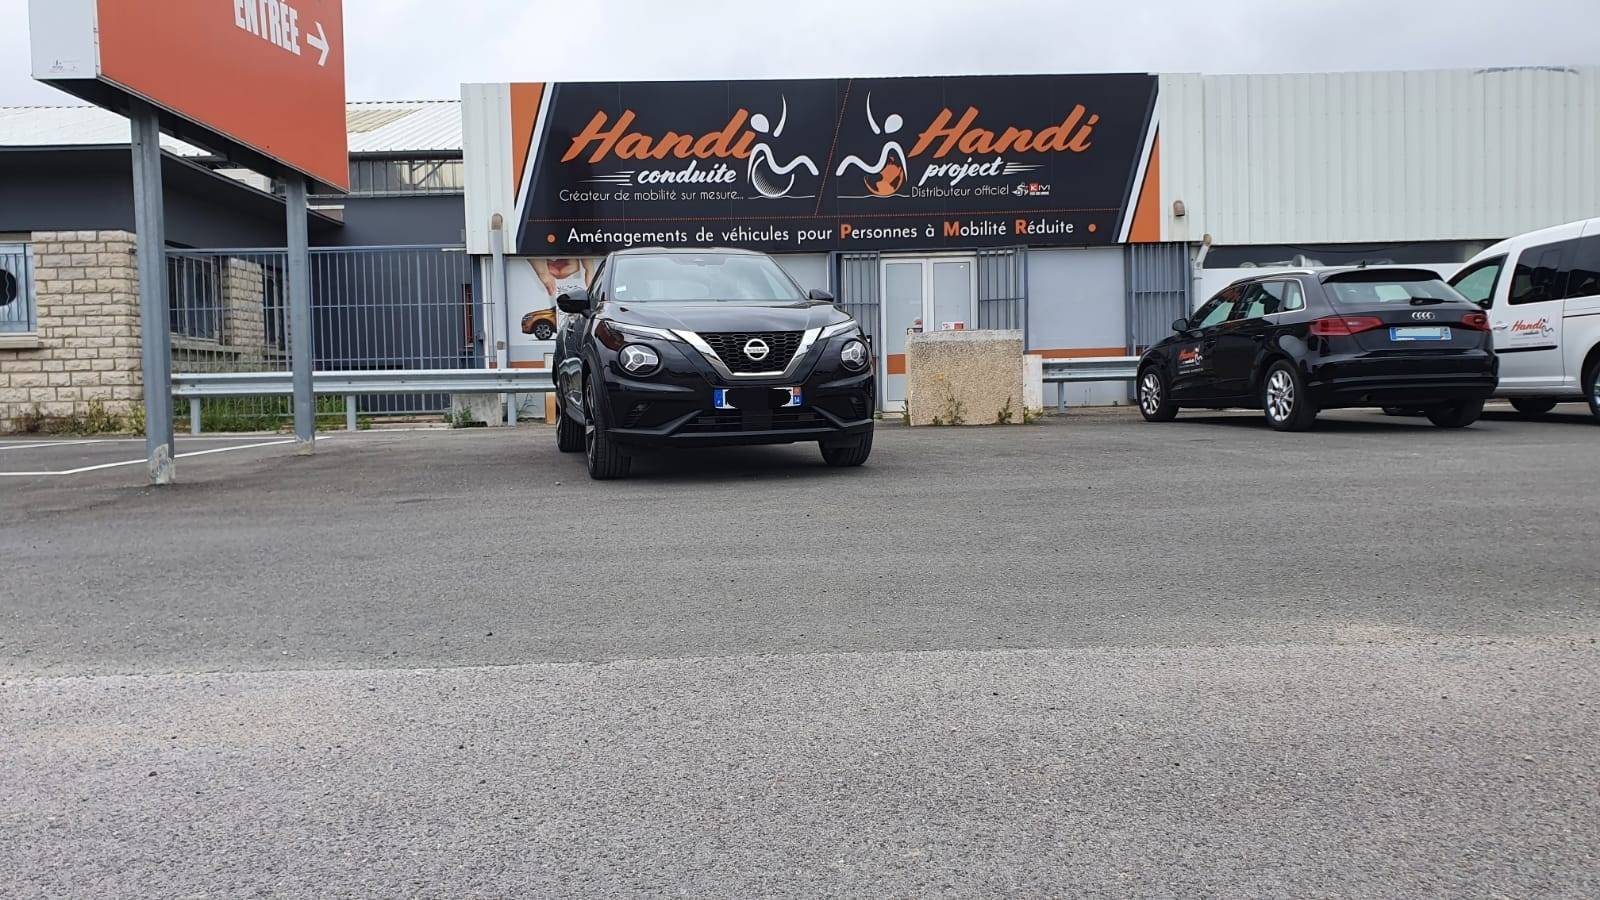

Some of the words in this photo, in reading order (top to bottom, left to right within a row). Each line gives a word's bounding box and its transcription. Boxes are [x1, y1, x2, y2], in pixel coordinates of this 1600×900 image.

[561, 108, 757, 163] Handi
[908, 103, 1100, 159] Handi
[637, 160, 737, 185] conduite
[918, 156, 1004, 187] project
[559, 189, 610, 202] Créateur
[614, 190, 630, 201] de
[634, 189, 677, 201] mobilité
[681, 191, 697, 201] sur
[911, 186, 972, 198] Distributeur
[974, 183, 1009, 196] officiel
[567, 227, 688, 246] Aménagements
[695, 226, 714, 242] de
[721, 225, 790, 242] véhicules
[797, 229, 832, 244] pour
[840, 223, 918, 239] Personnes
[925, 223, 935, 238] à
[943, 220, 1007, 237] Mobilité
[1015, 218, 1074, 235] Réduite
